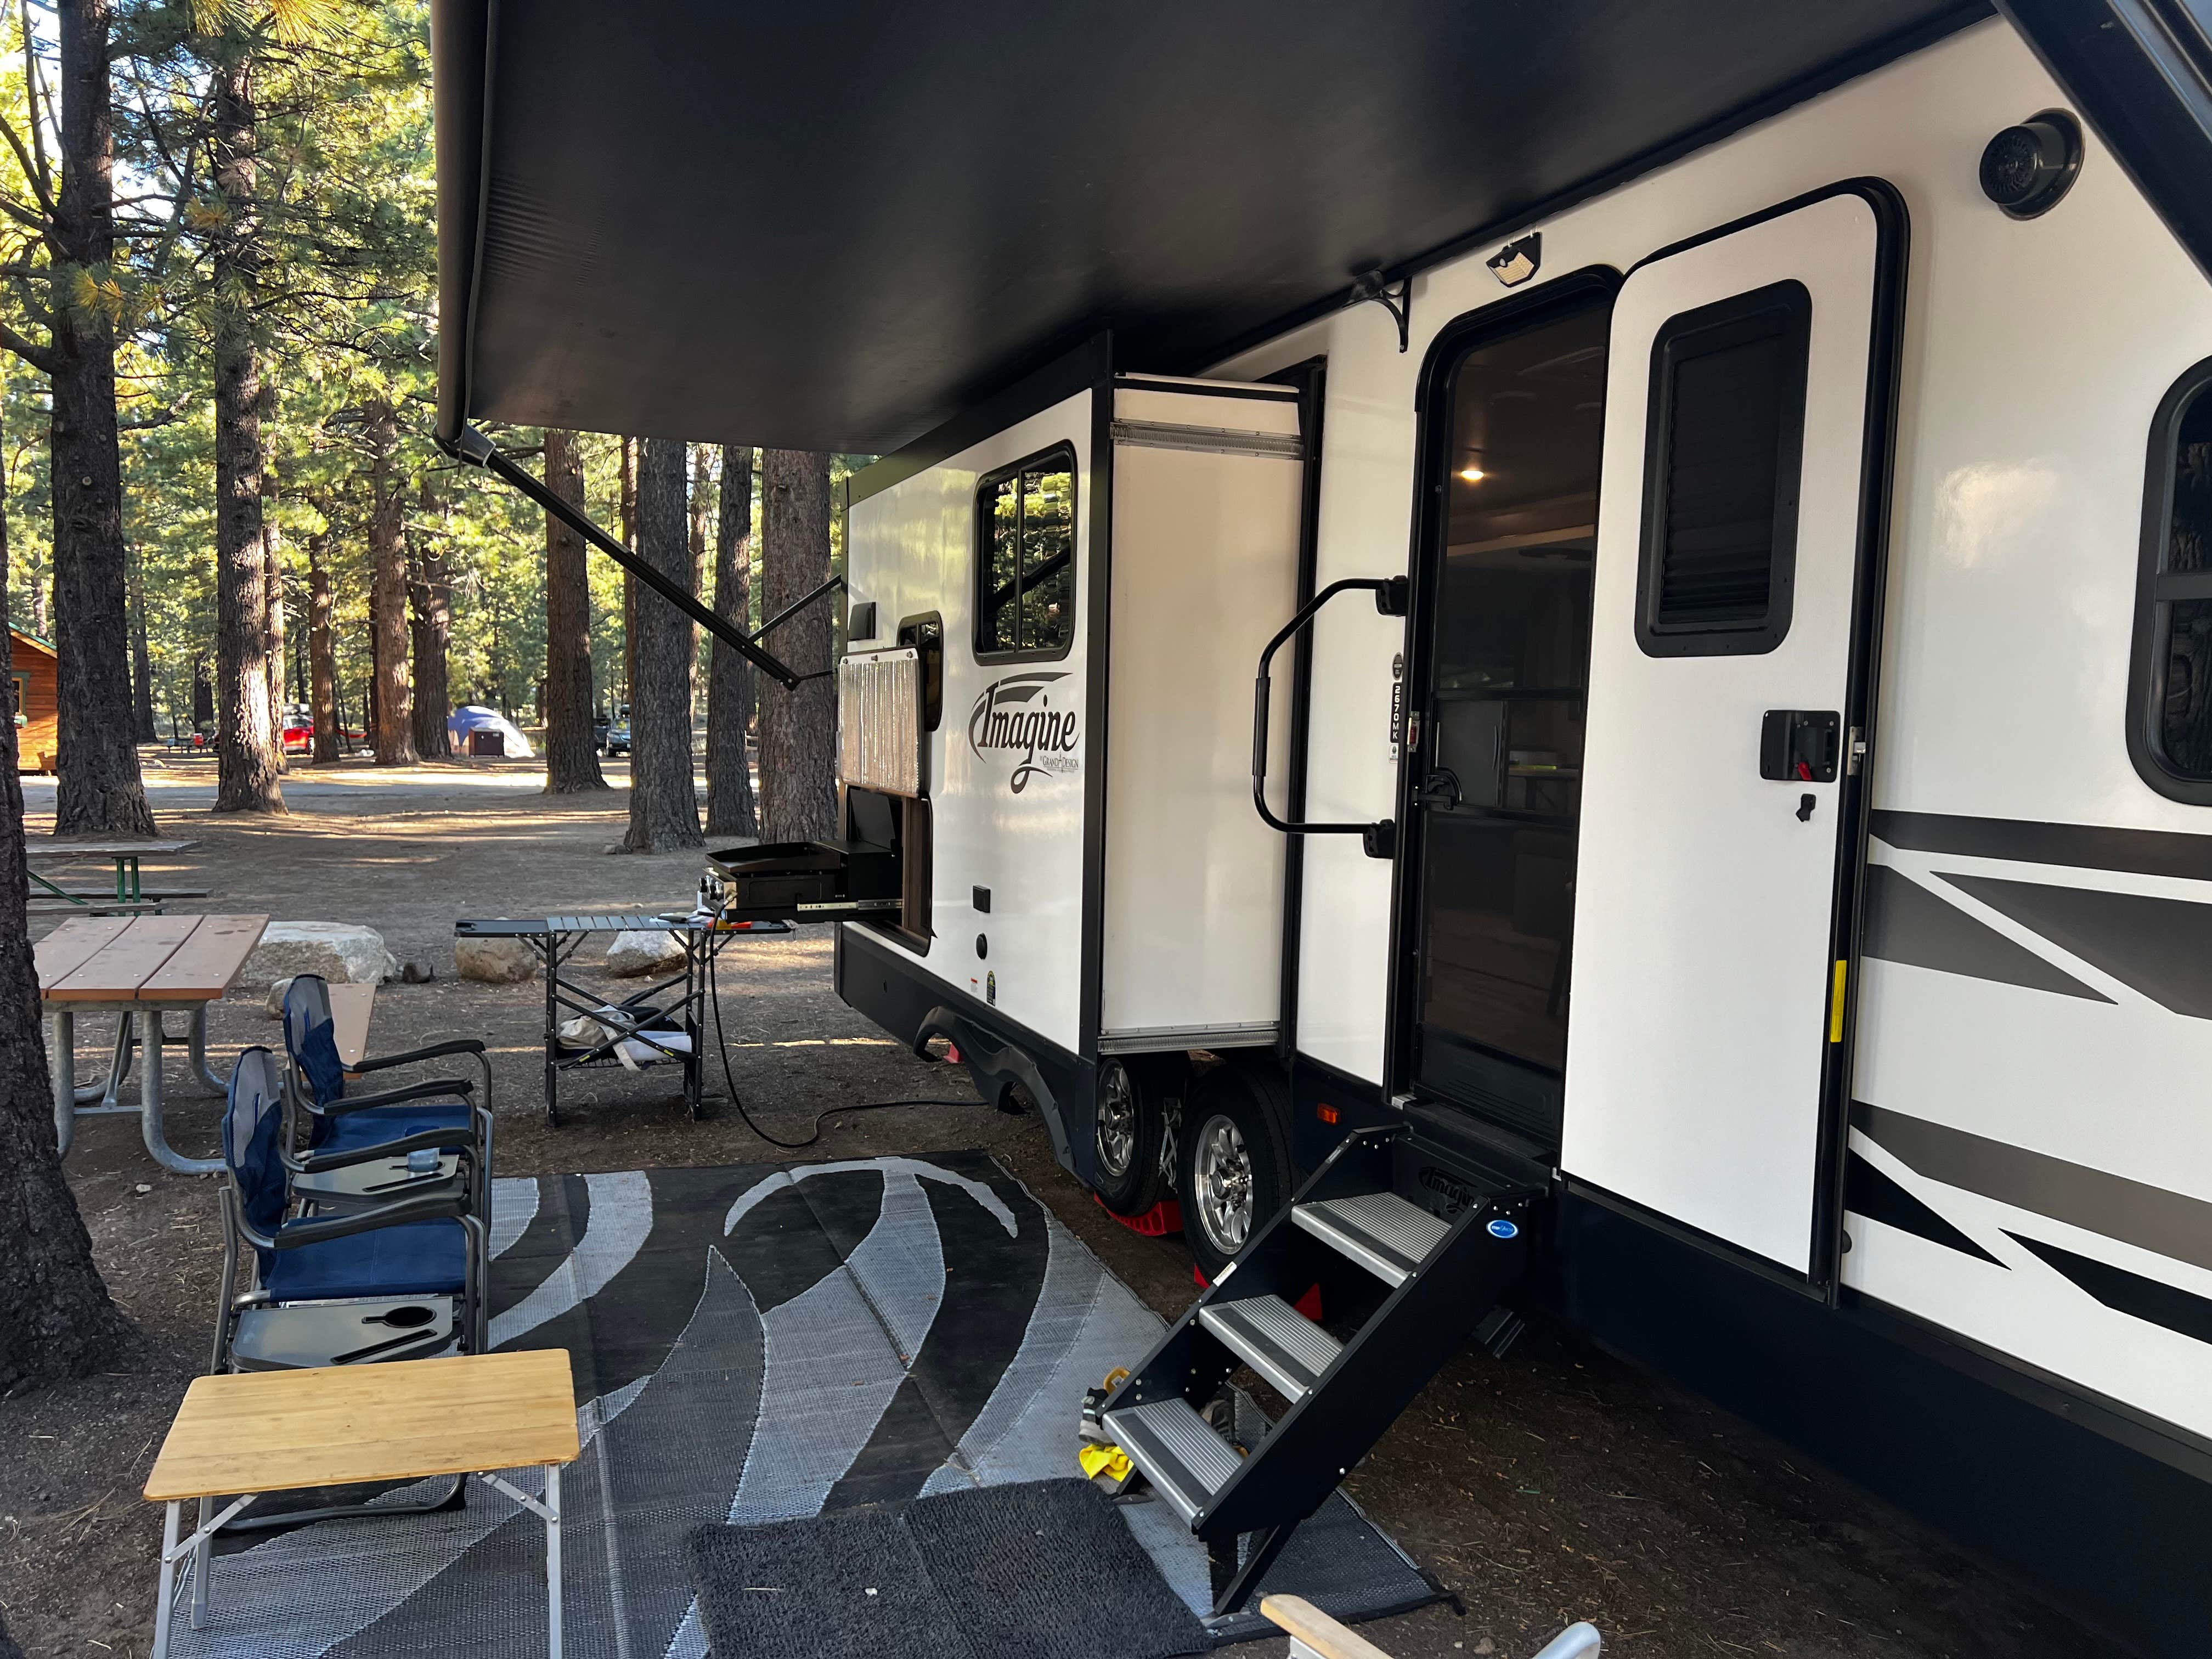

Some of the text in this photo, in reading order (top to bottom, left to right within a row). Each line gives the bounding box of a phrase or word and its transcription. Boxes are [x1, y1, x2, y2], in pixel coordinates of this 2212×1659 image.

[977, 681, 1080, 794] Imagine
[1392, 685, 1401, 740] 2670MK
[1042, 755, 1059, 766] GRAND
[1062, 757, 1079, 768] DESIGN
[1423, 1167, 1475, 1214] Imagin
